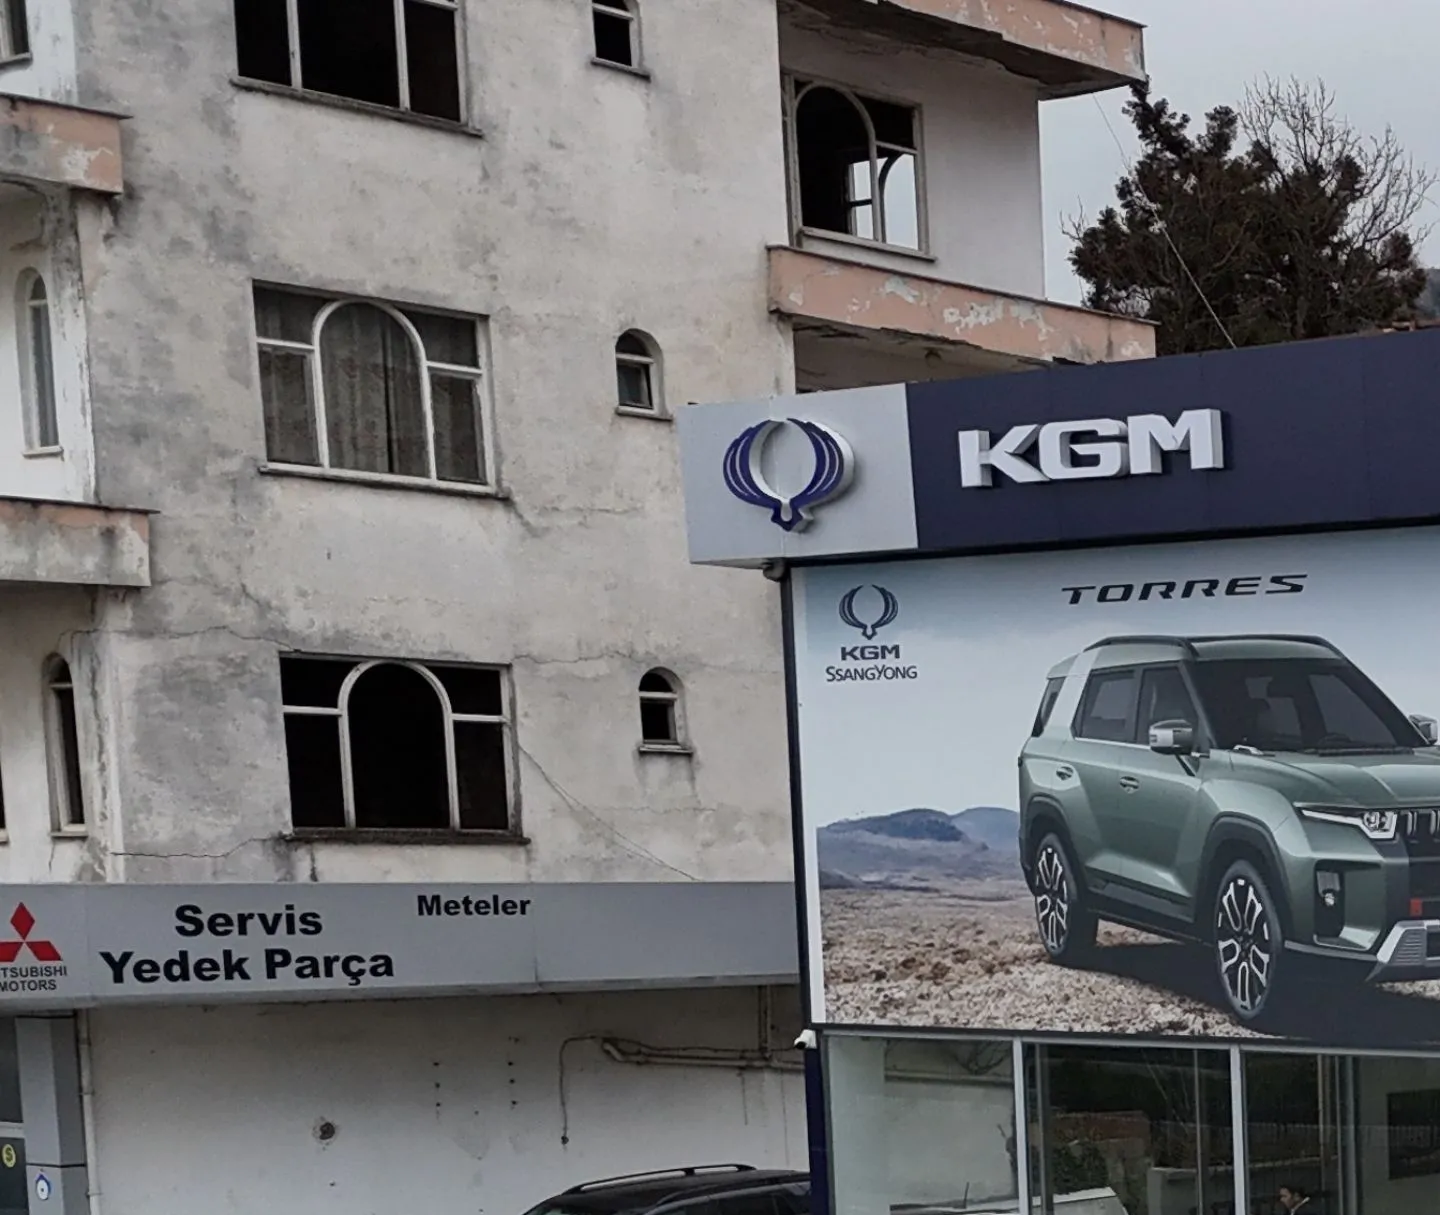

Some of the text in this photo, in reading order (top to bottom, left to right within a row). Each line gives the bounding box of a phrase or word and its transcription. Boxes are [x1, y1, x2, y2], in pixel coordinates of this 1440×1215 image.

[958, 408, 1223, 488] KGM
[1061, 574, 1308, 605] TORRES
[841, 644, 900, 661] KGM
[174, 902, 324, 938] Servis
[417, 894, 531, 917] Meteler
[100, 948, 394, 986] Yedek Parça
[0, 979, 57, 992] MOTORS
